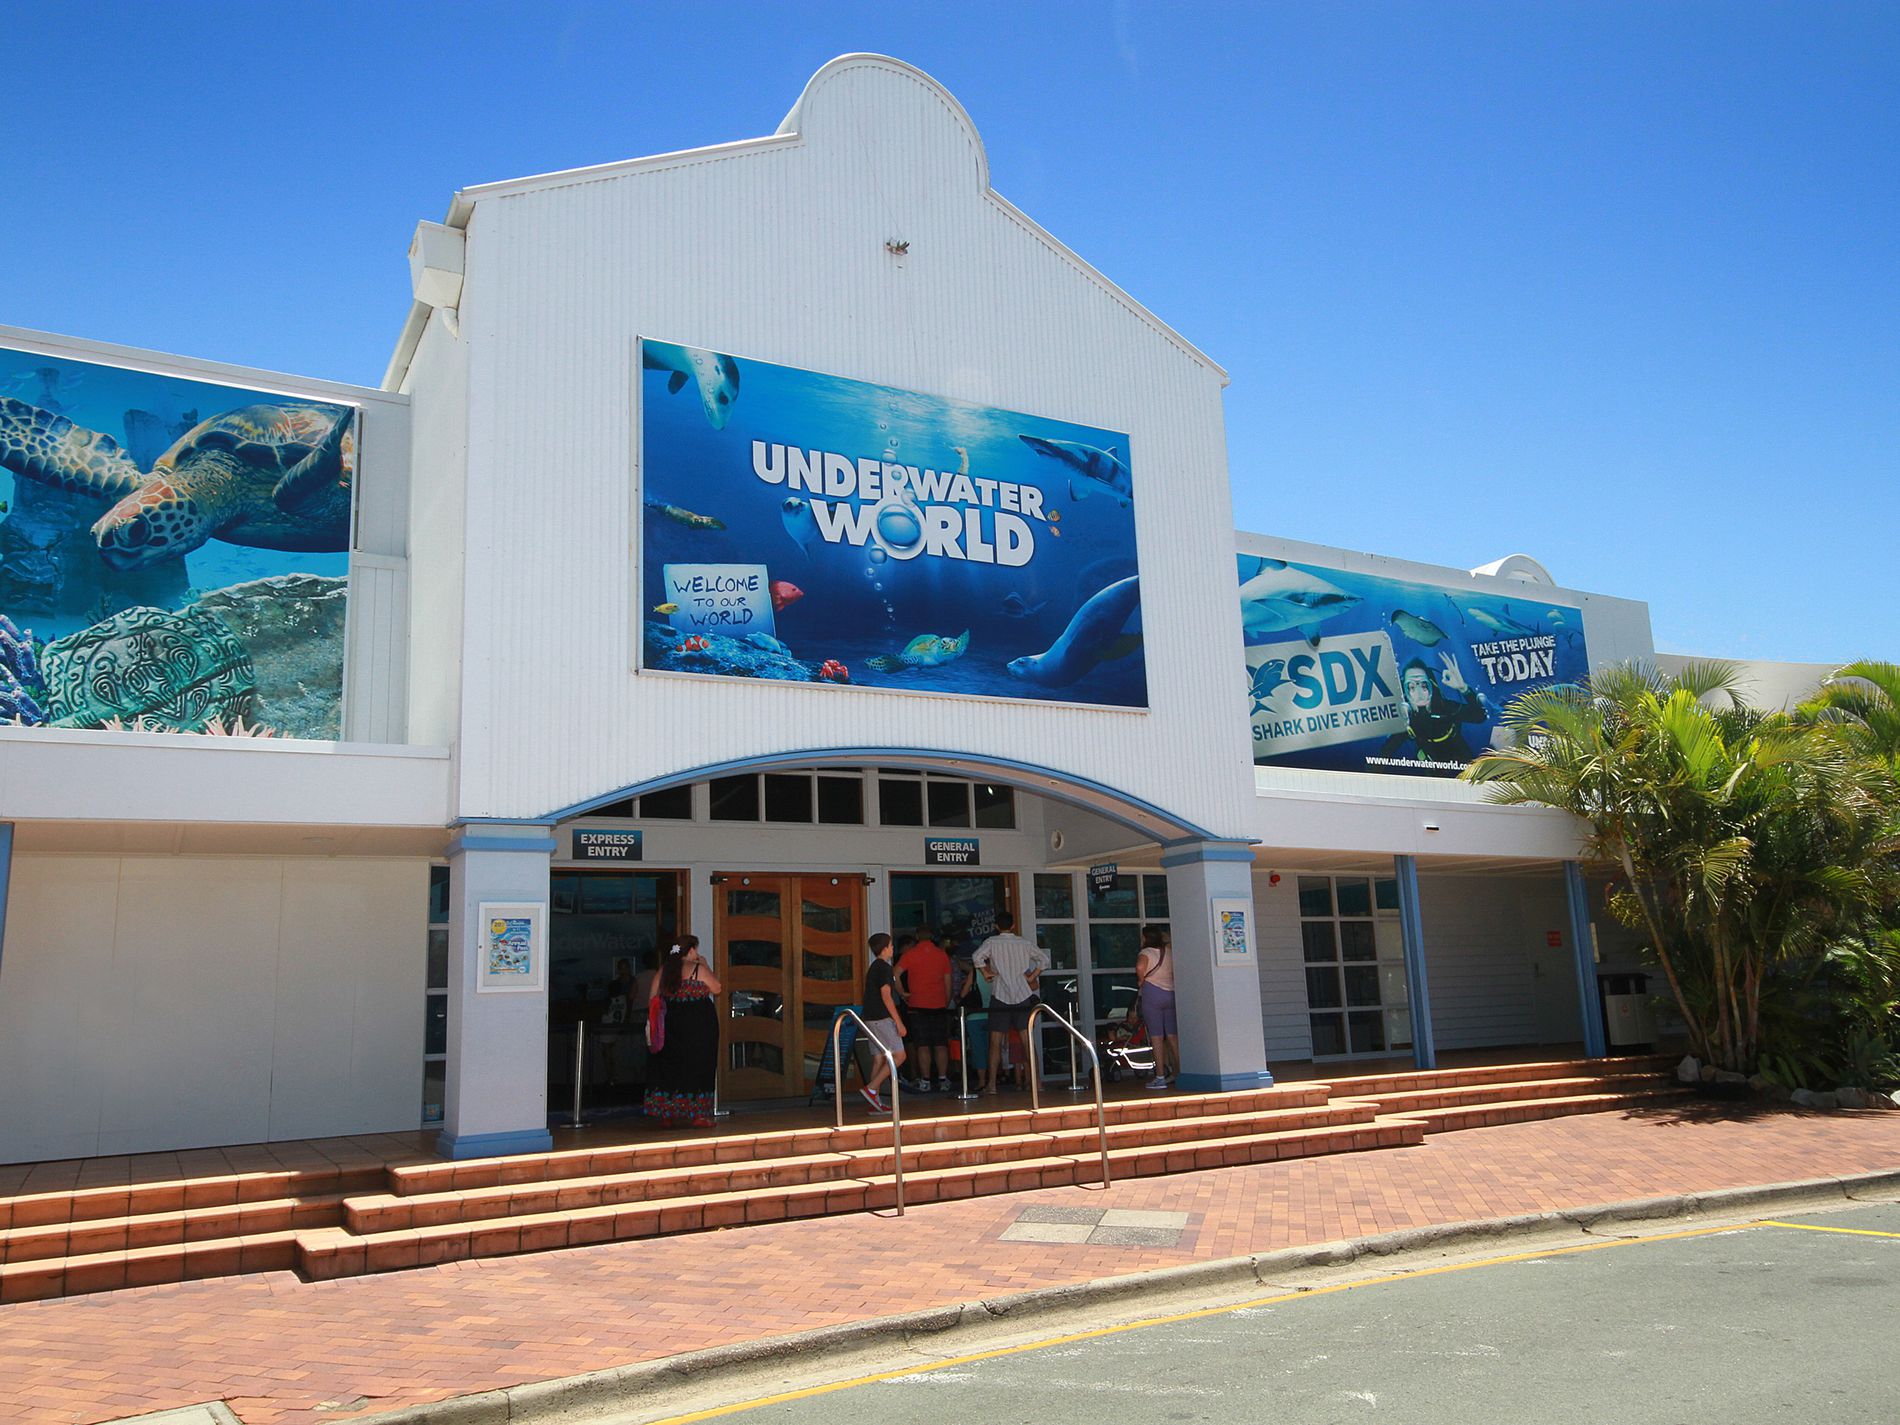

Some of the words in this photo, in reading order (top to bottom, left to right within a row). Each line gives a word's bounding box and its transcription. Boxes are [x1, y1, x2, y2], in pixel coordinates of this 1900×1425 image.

[752, 440, 1047, 522] UNDERWATER
[810, 498, 1035, 568] WORLD
[673, 574, 759, 593] WELCOME
[693, 597, 714, 607] TO
[720, 596, 746, 607] OUR
[690, 608, 753, 626] WORLD
[1471, 642, 1500, 657] TAKE
[1499, 639, 1520, 653] THE
[1519, 635, 1556, 651] PLUNGE
[1481, 649, 1554, 685] TODAY
[1287, 645, 1394, 710] SDX
[1252, 718, 1304, 741] SHARK
[1307, 711, 1341, 733] DIVE
[1343, 703, 1399, 727] XTREME
[580, 833, 635, 845] EXPRESS
[930, 841, 976, 852] GENERAL
[587, 846, 629, 857] ENTRY
[937, 852, 969, 862] ENTRY
